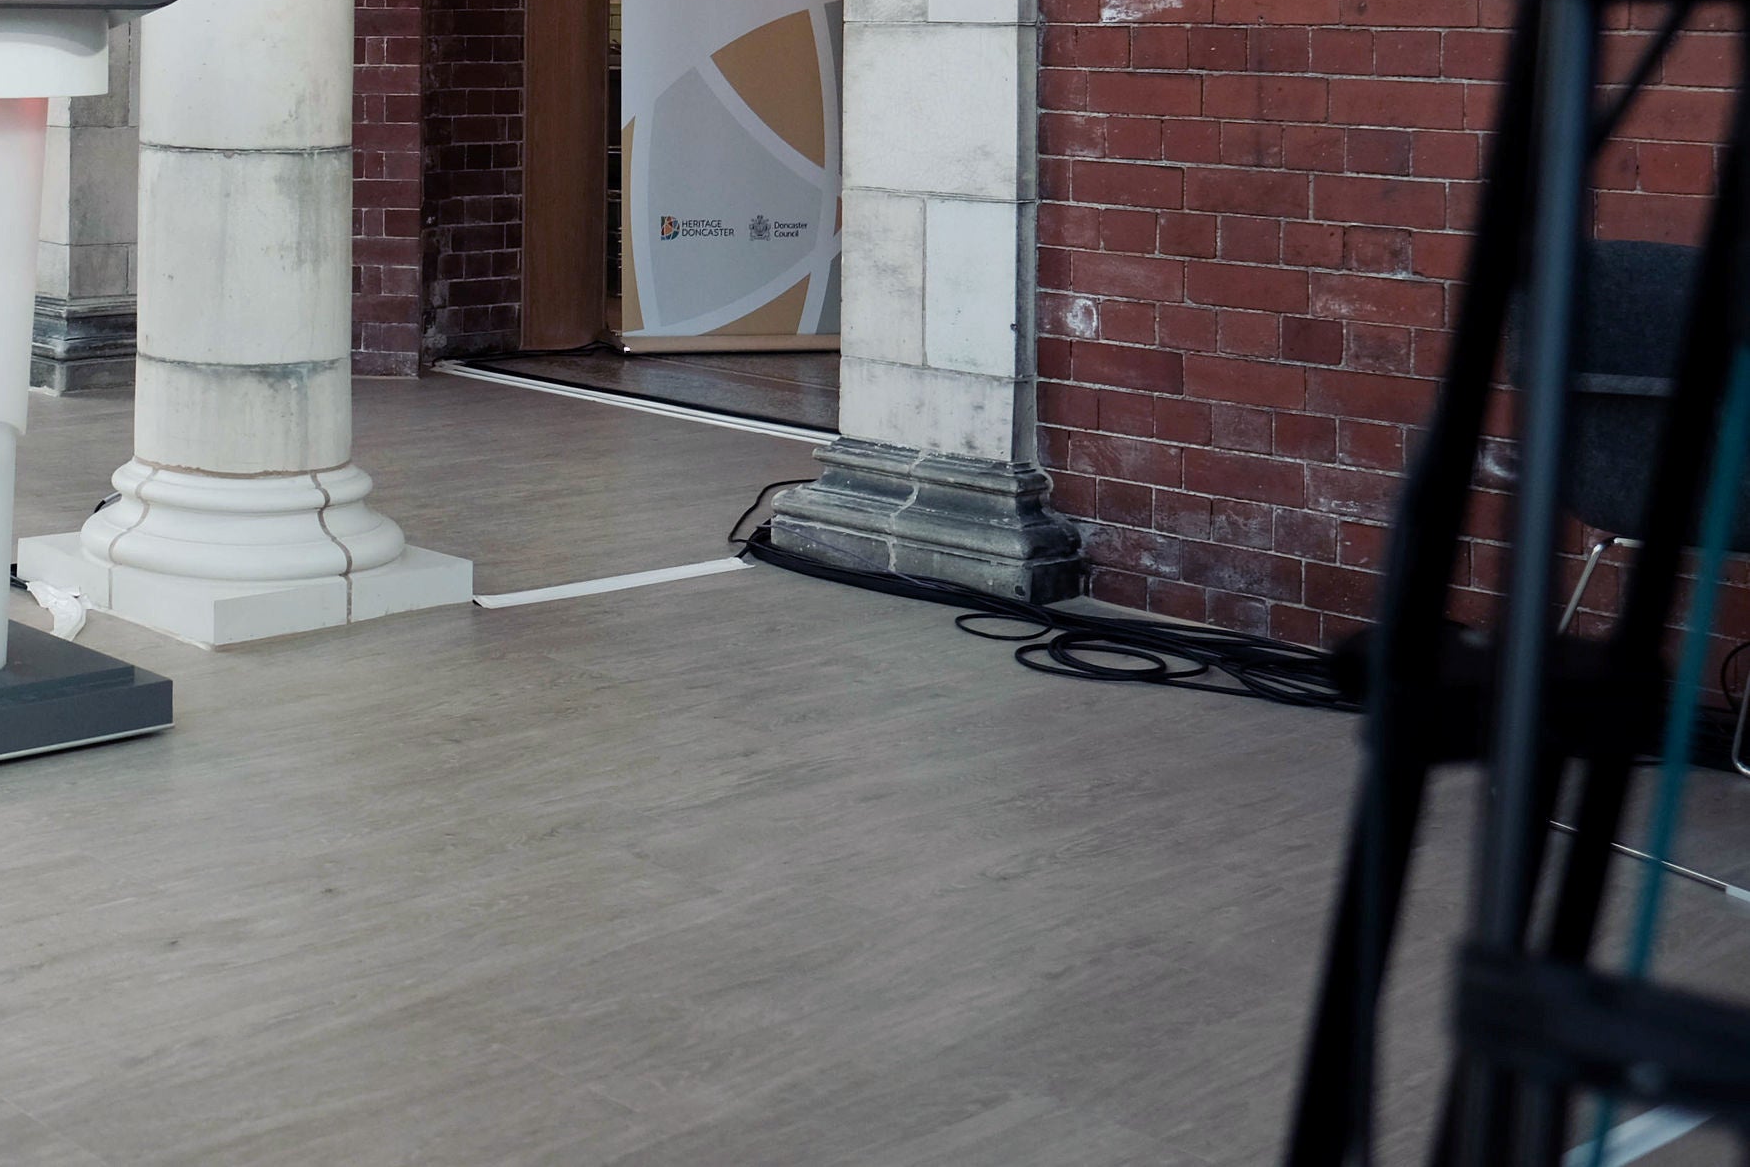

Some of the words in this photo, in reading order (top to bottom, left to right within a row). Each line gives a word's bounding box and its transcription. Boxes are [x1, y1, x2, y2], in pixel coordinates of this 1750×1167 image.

[682, 219, 722, 228] HERITAGE
[774, 221, 808, 229] Doncaster
[682, 228, 735, 237] DONCASTER
[774, 229, 799, 238] Council
